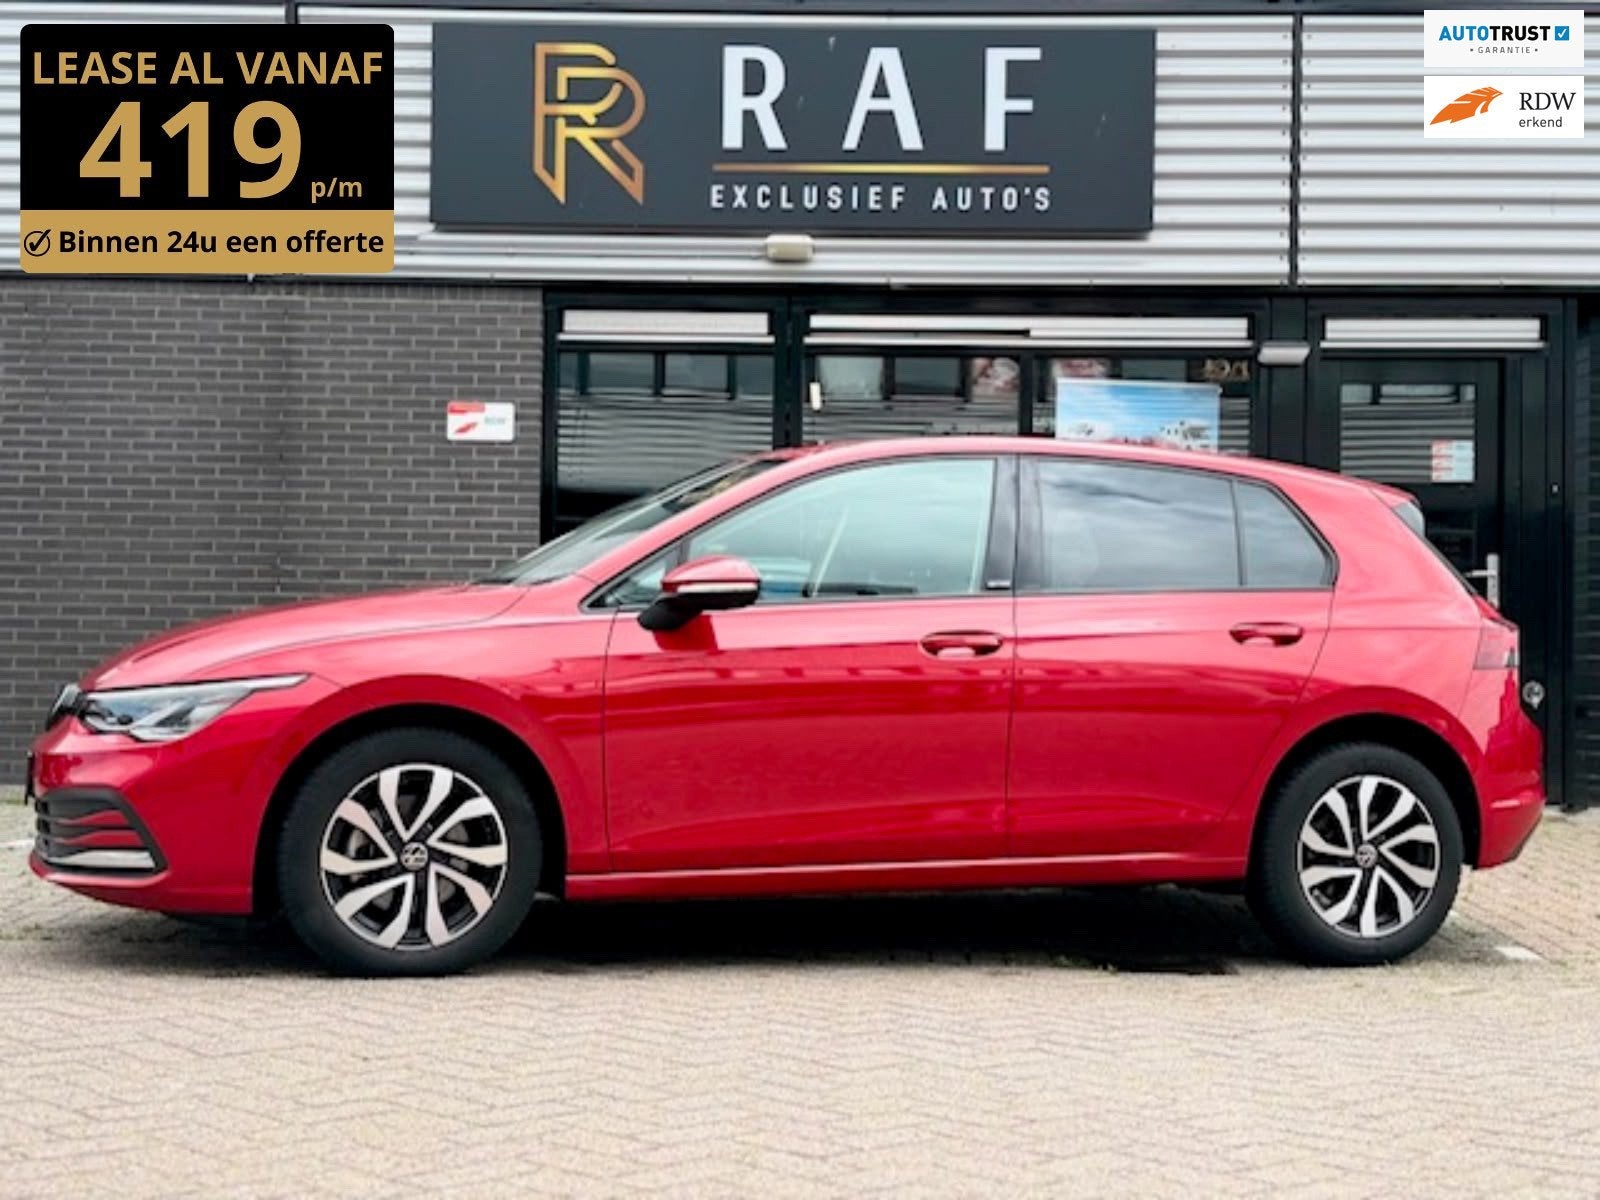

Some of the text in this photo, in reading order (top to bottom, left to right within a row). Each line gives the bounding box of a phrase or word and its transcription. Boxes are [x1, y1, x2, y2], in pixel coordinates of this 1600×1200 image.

[721, 45, 1042, 151] RAF
[710, 184, 1051, 211] EXCLUSIEF AUTO'S
